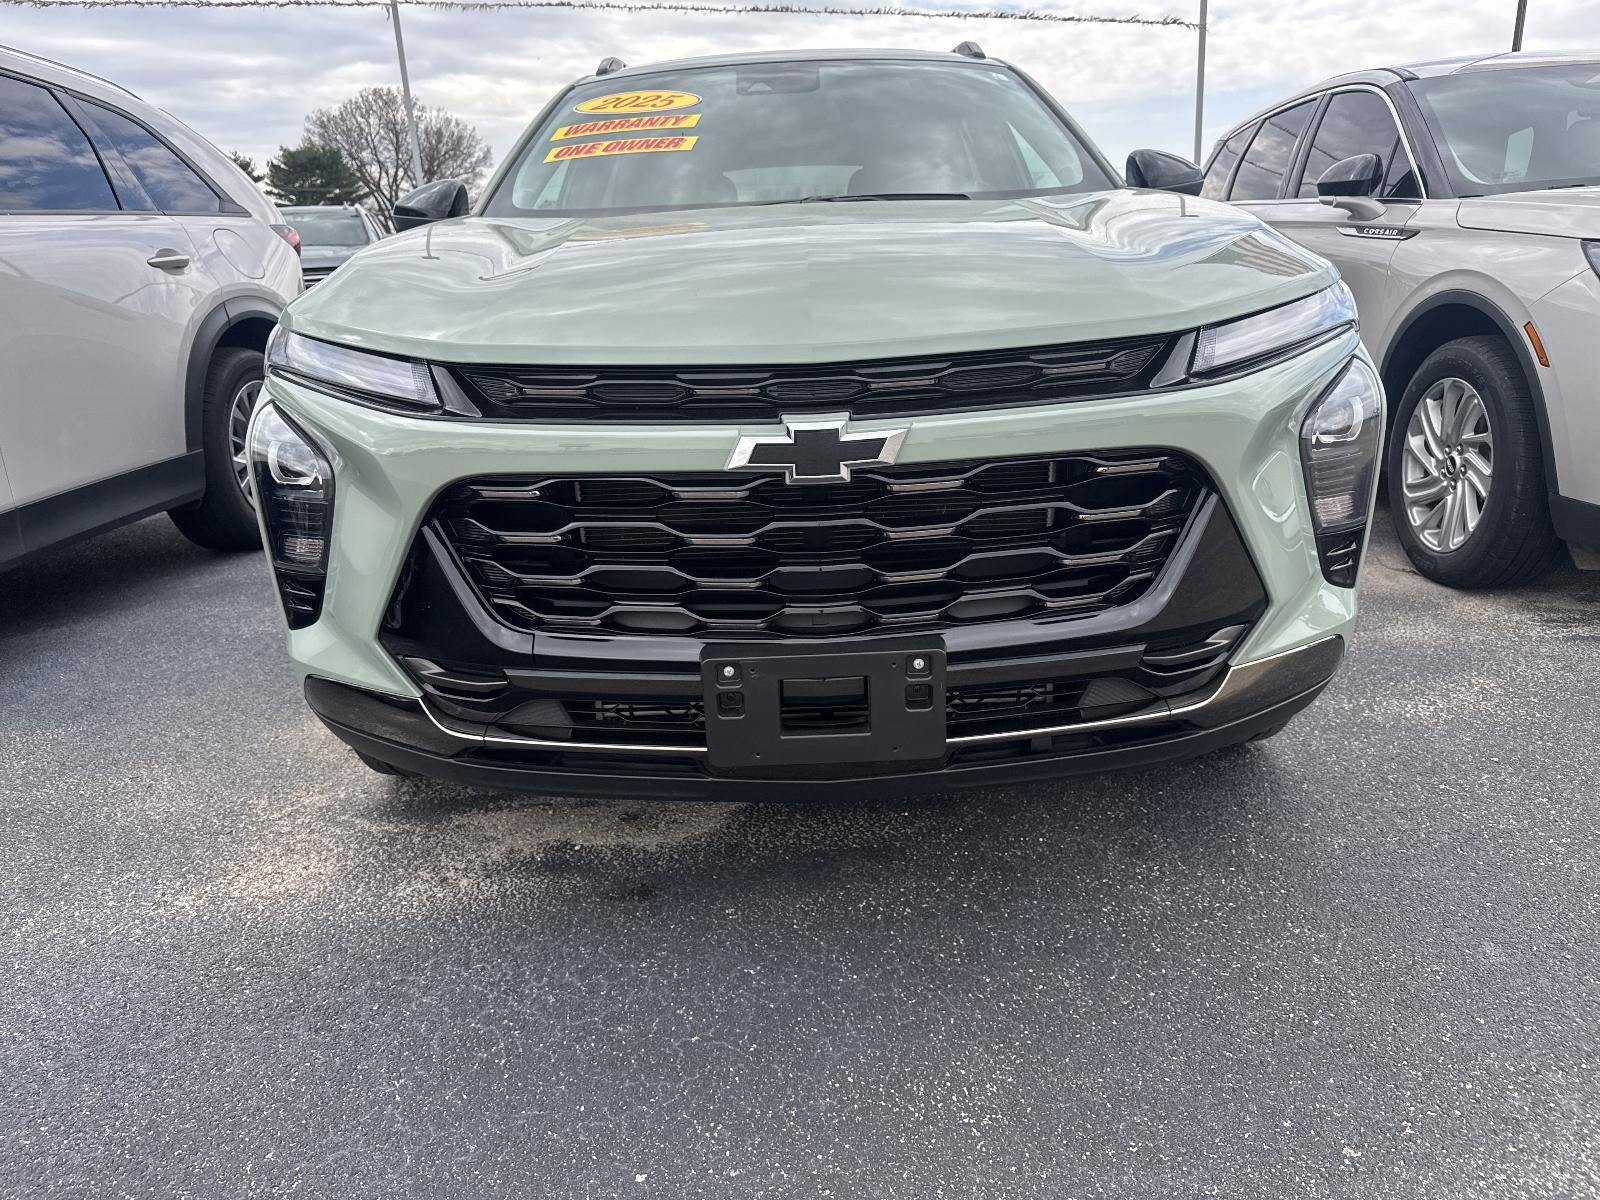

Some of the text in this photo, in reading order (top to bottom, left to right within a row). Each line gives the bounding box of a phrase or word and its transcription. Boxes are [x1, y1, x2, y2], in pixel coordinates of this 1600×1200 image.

[590, 95, 683, 110] 2025
[563, 115, 688, 137] WARRANTY
[553, 137, 687, 159] ONE OWNER
[1363, 228, 1399, 236] CORSAIR
